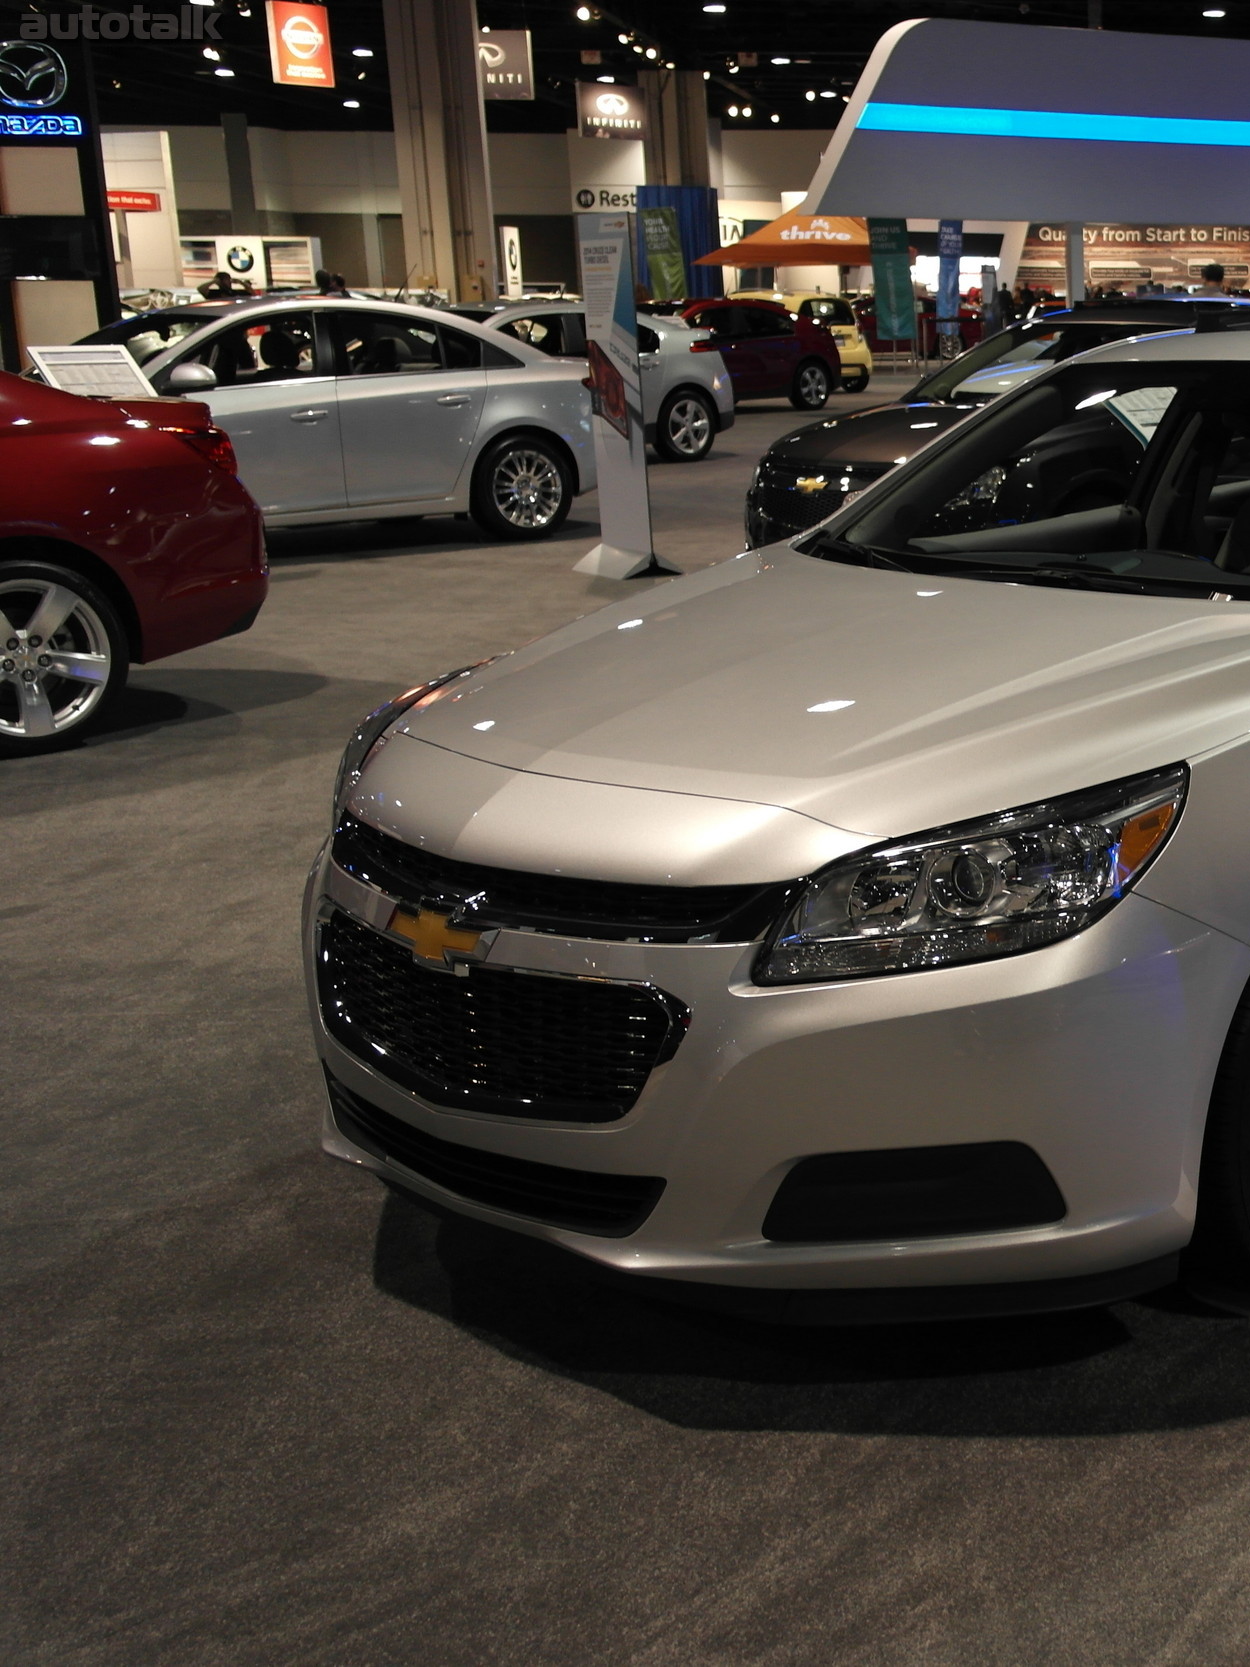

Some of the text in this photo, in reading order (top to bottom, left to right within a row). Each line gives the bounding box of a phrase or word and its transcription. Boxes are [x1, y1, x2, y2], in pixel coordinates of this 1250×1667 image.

[587, 117, 642, 129] INFINITI
[779, 226, 852, 241] thrive
[871, 226, 900, 234] JOIN US
[1102, 227, 1140, 242] from
[1146, 228, 1185, 242] Start
[1191, 229, 1207, 242] to
